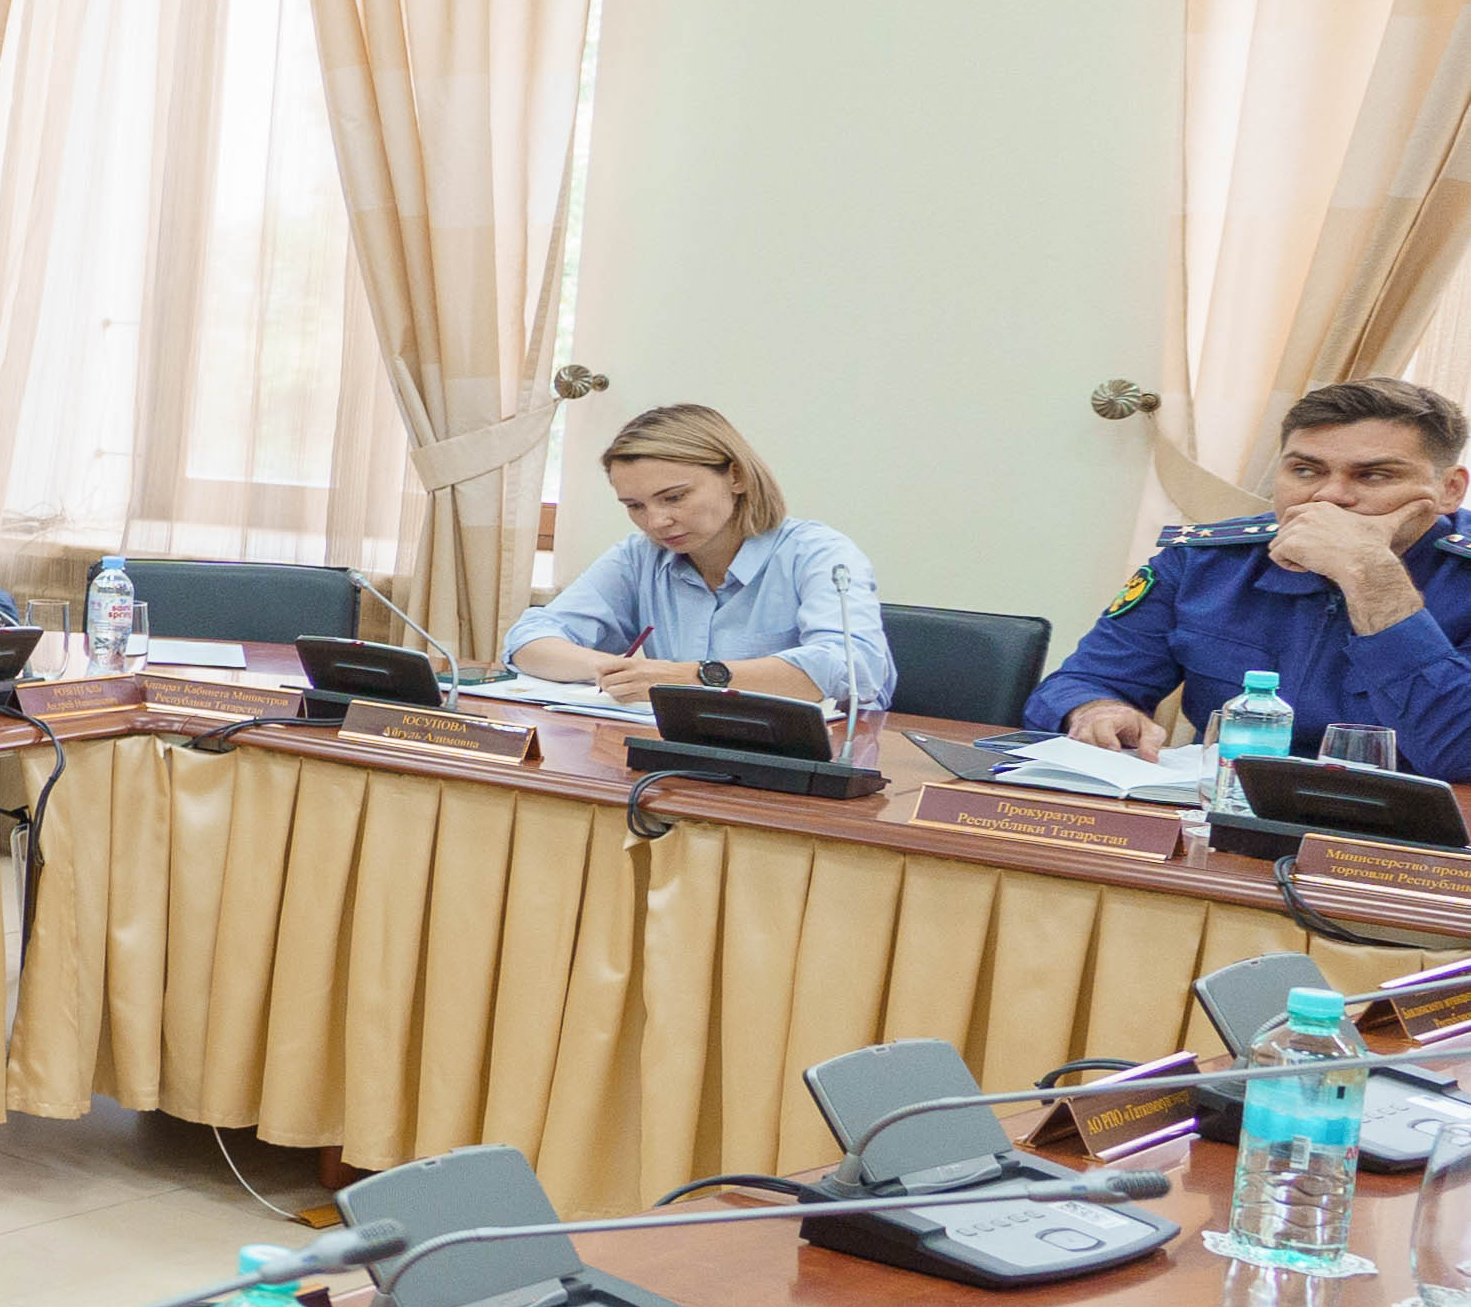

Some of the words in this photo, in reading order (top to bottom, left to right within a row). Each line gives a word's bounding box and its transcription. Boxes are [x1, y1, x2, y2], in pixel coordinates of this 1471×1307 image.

[184, 685, 229, 699] Кабинета
[232, 690, 289, 707] Министров
[215, 701, 264, 717] Татарстан
[403, 715, 467, 733] ЮСУПОВА
[383, 726, 421, 740] Айгуль
[424, 733, 479, 749] Алимовна
[997, 801, 1096, 826] Прокуратура
[957, 812, 1046, 837] Республики
[1051, 825, 1129, 847] Татарстан
[1326, 848, 1429, 872] Министерство
[1330, 864, 1394, 882] торговли
[1087, 1116, 1103, 1135] АО
[1101, 1108, 1124, 1130] РПО
